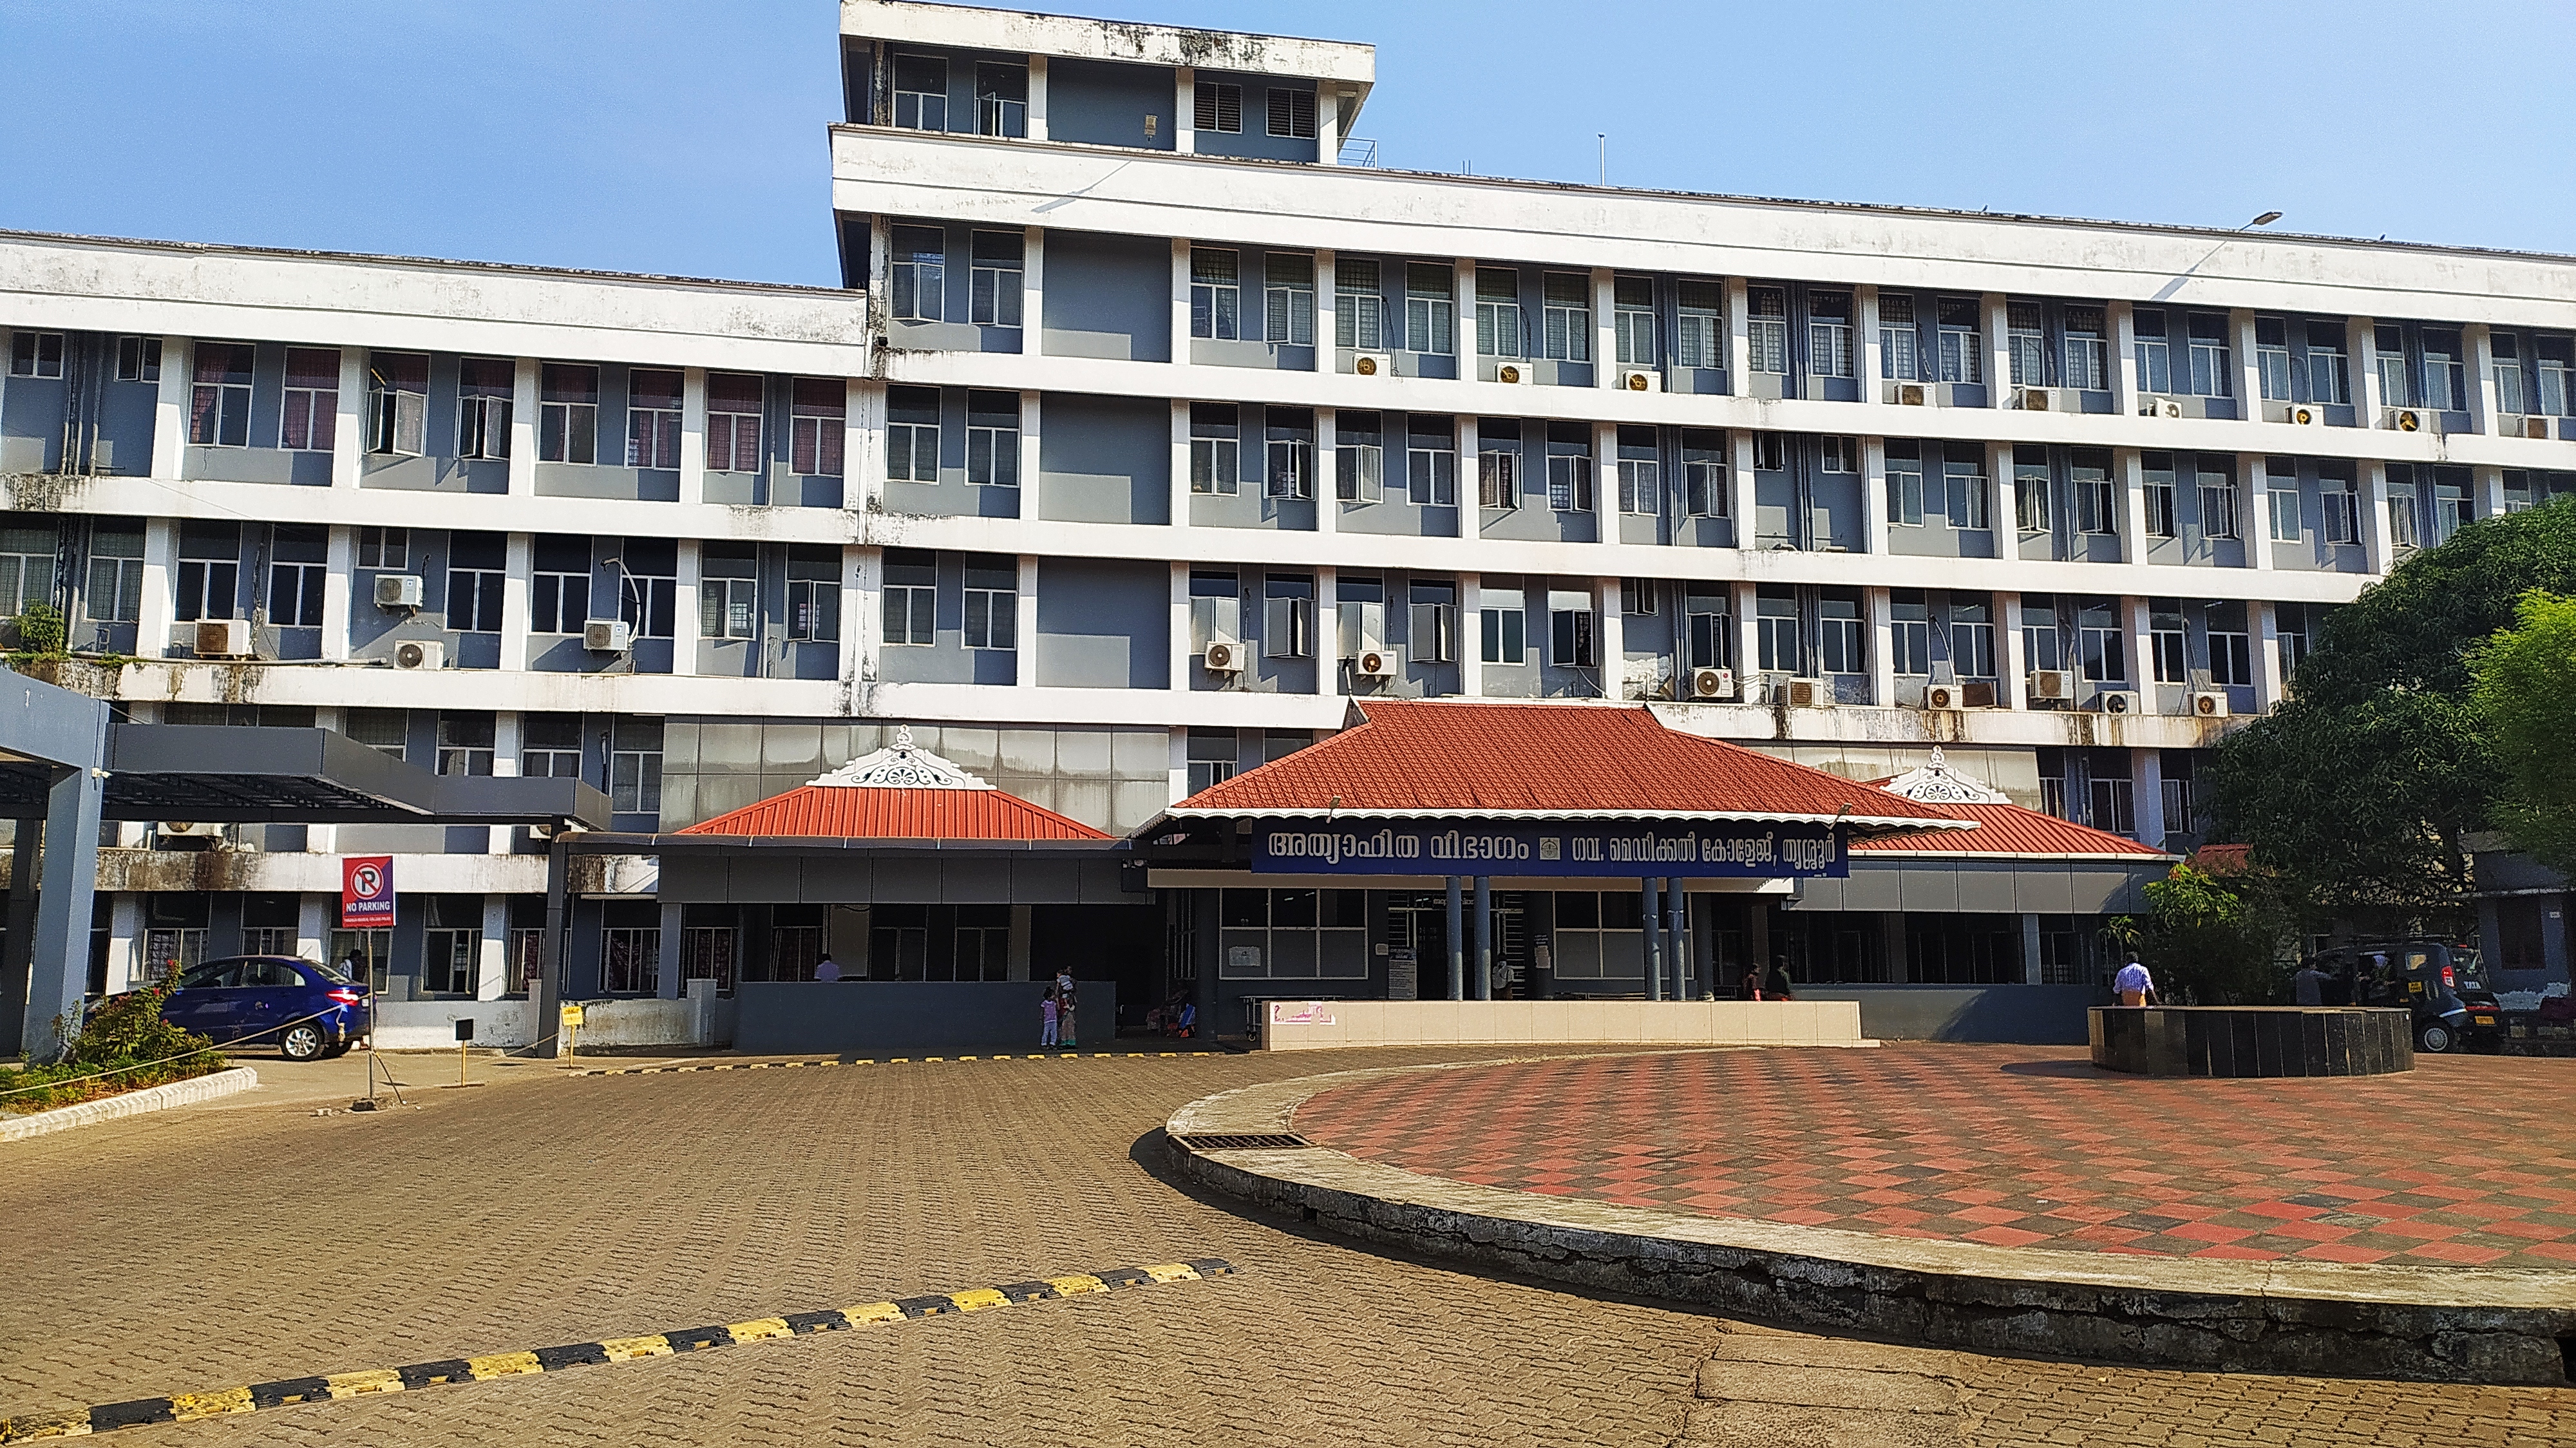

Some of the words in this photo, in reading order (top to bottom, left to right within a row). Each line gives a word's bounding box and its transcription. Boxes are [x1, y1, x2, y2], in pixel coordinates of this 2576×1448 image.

[1268, 828, 1419, 864] അത്യാഹിത
[1430, 830, 1530, 859] വിഭാഗം
[1572, 837, 1604, 861] ഗവ.
[1609, 831, 1696, 862] മെഡിക്കൽ
[1701, 831, 1777, 868] കോളേജ്,
[1783, 832, 1835, 870] തൃശ്ശൂർ
[346, 902, 357, 912] NO
[358, 900, 390, 911] PARKING
